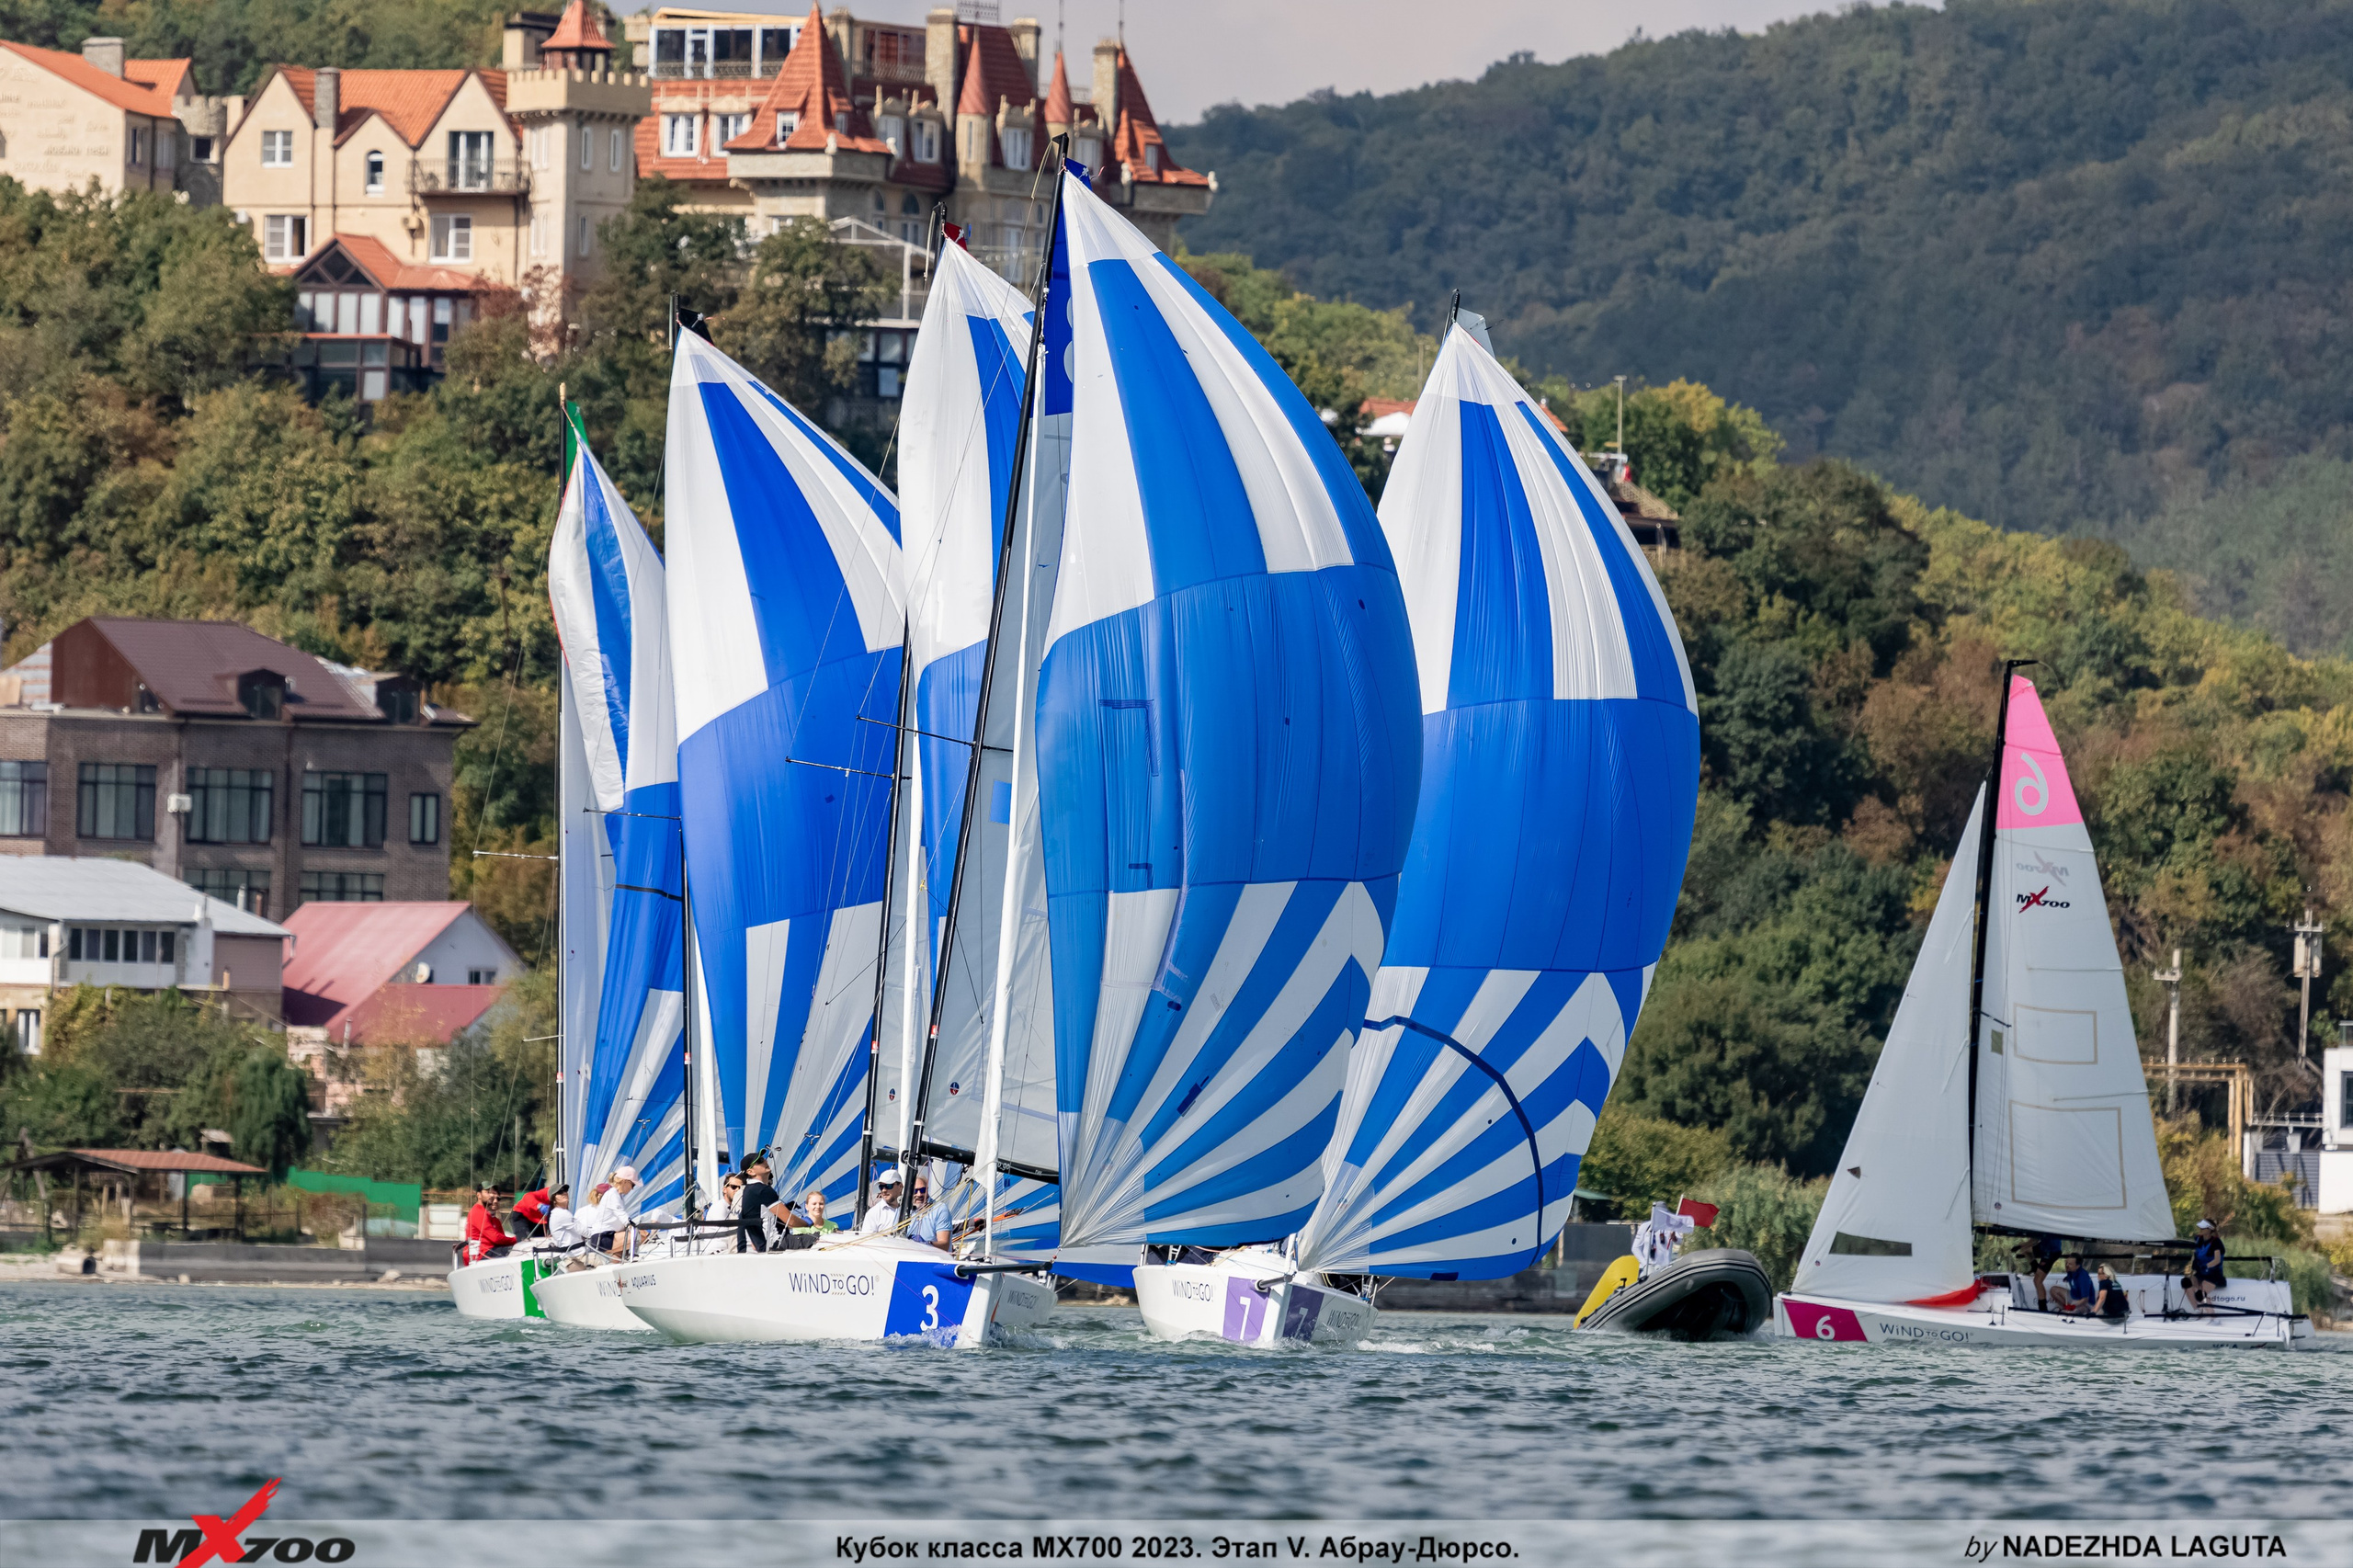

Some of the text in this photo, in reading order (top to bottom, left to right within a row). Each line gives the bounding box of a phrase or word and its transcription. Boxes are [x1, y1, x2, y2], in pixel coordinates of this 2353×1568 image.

[2016, 885, 2070, 914] MX700
[920, 1285, 938, 1332] 3
[1815, 1314, 1836, 1341] 6
